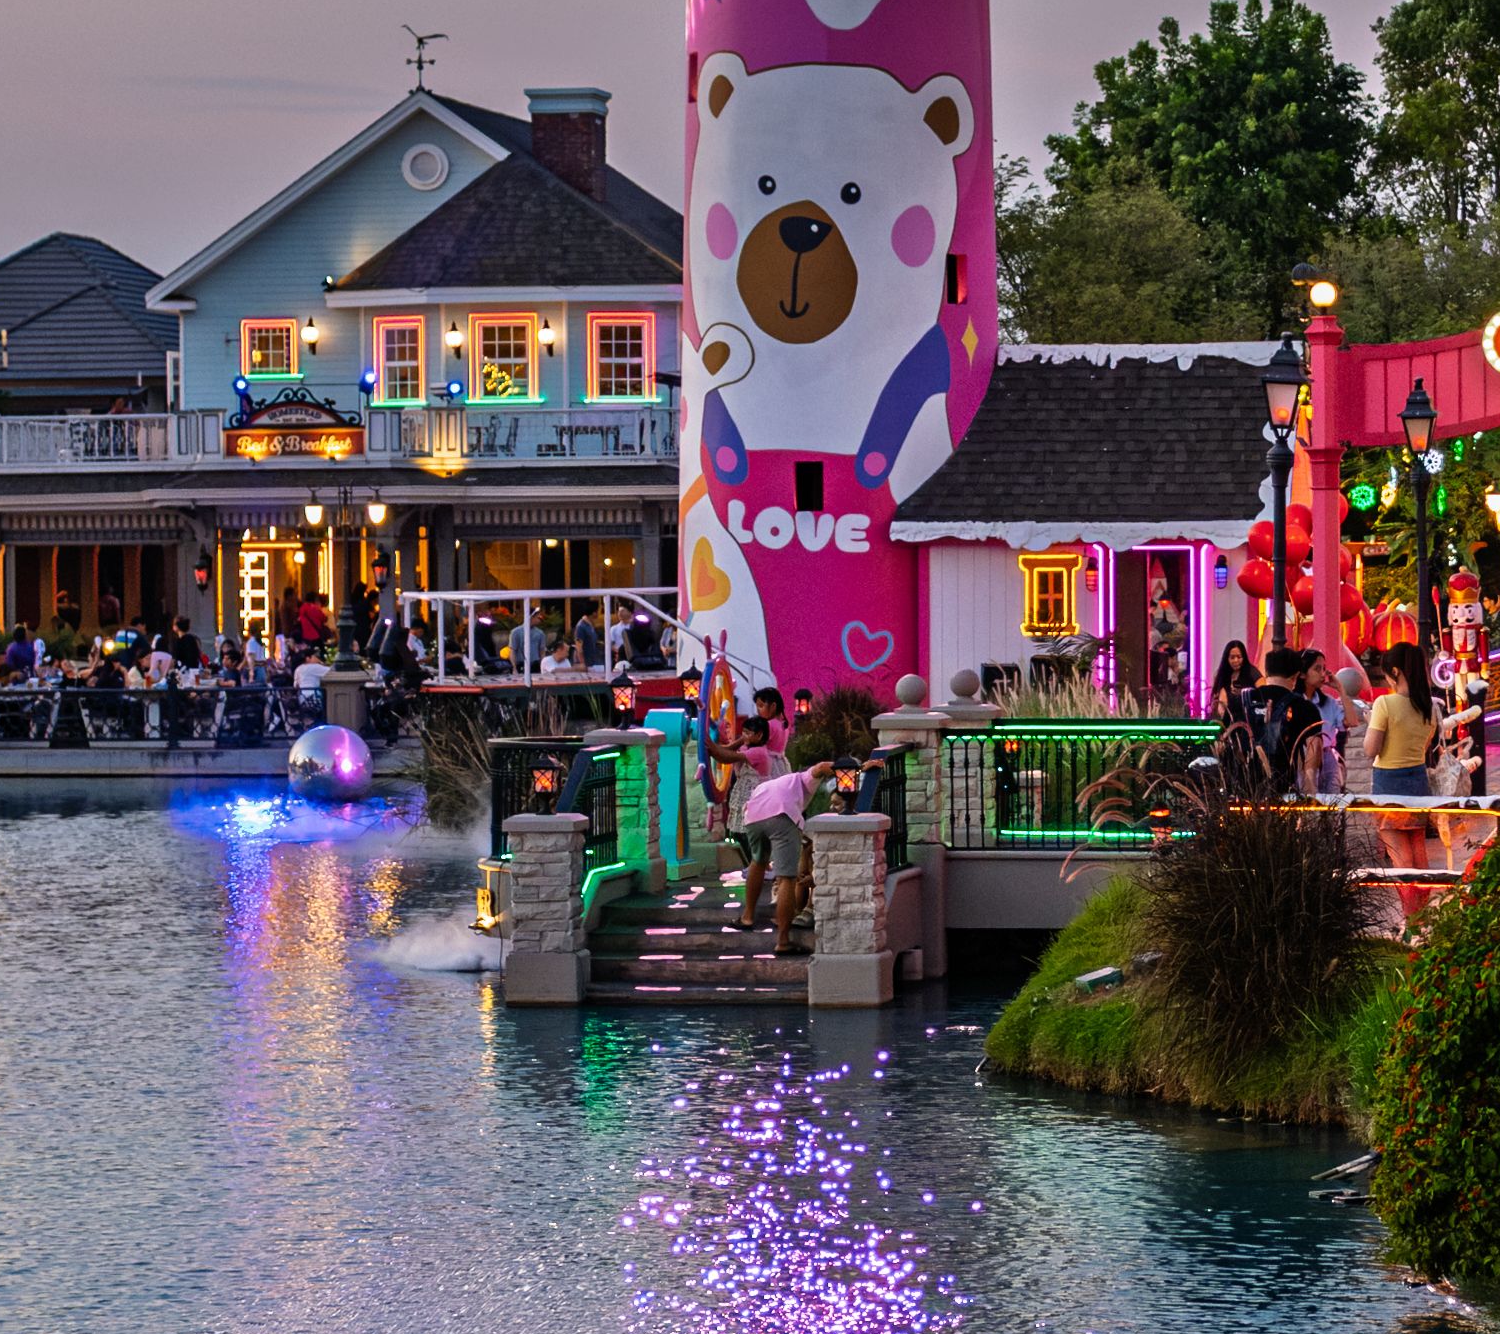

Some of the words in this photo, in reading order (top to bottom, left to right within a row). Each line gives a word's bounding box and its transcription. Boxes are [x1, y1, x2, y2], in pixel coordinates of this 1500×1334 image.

[236, 436, 269, 453] Bed
[269, 436, 284, 456] &
[285, 434, 352, 454] Breakfast
[727, 499, 871, 553] LOVE
